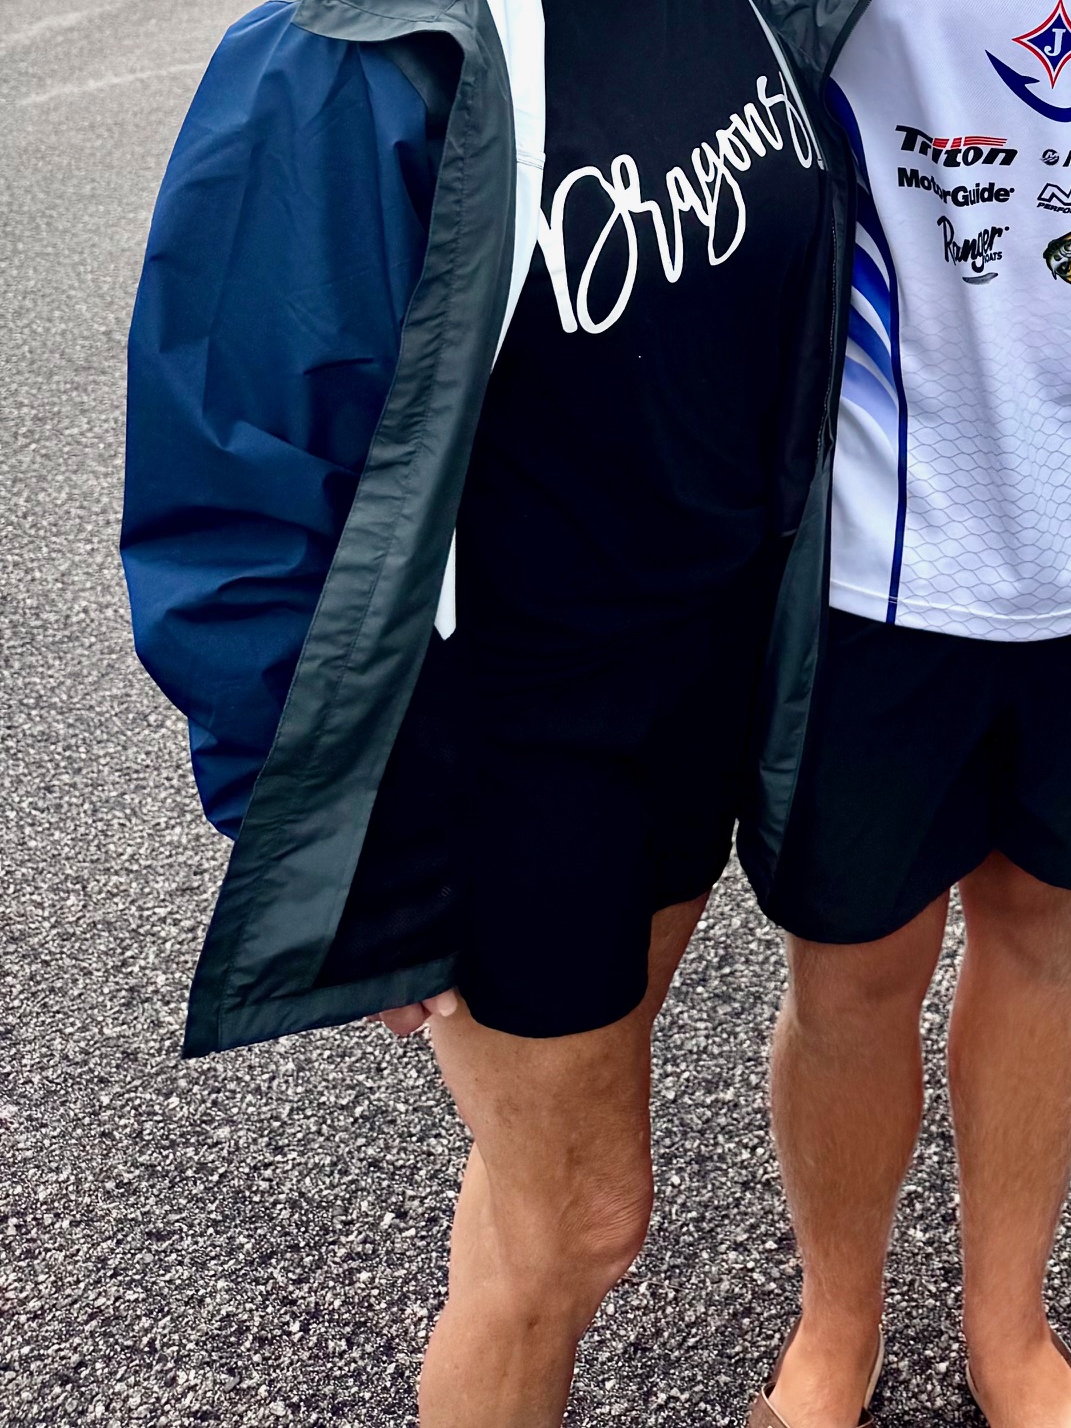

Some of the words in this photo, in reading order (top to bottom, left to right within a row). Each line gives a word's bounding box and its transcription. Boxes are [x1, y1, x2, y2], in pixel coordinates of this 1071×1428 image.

[1043, 27, 1067, 57] J
[895, 124, 1018, 168] Triton
[897, 166, 1010, 207] MotorGuide
[936, 215, 1004, 273] Ranger
